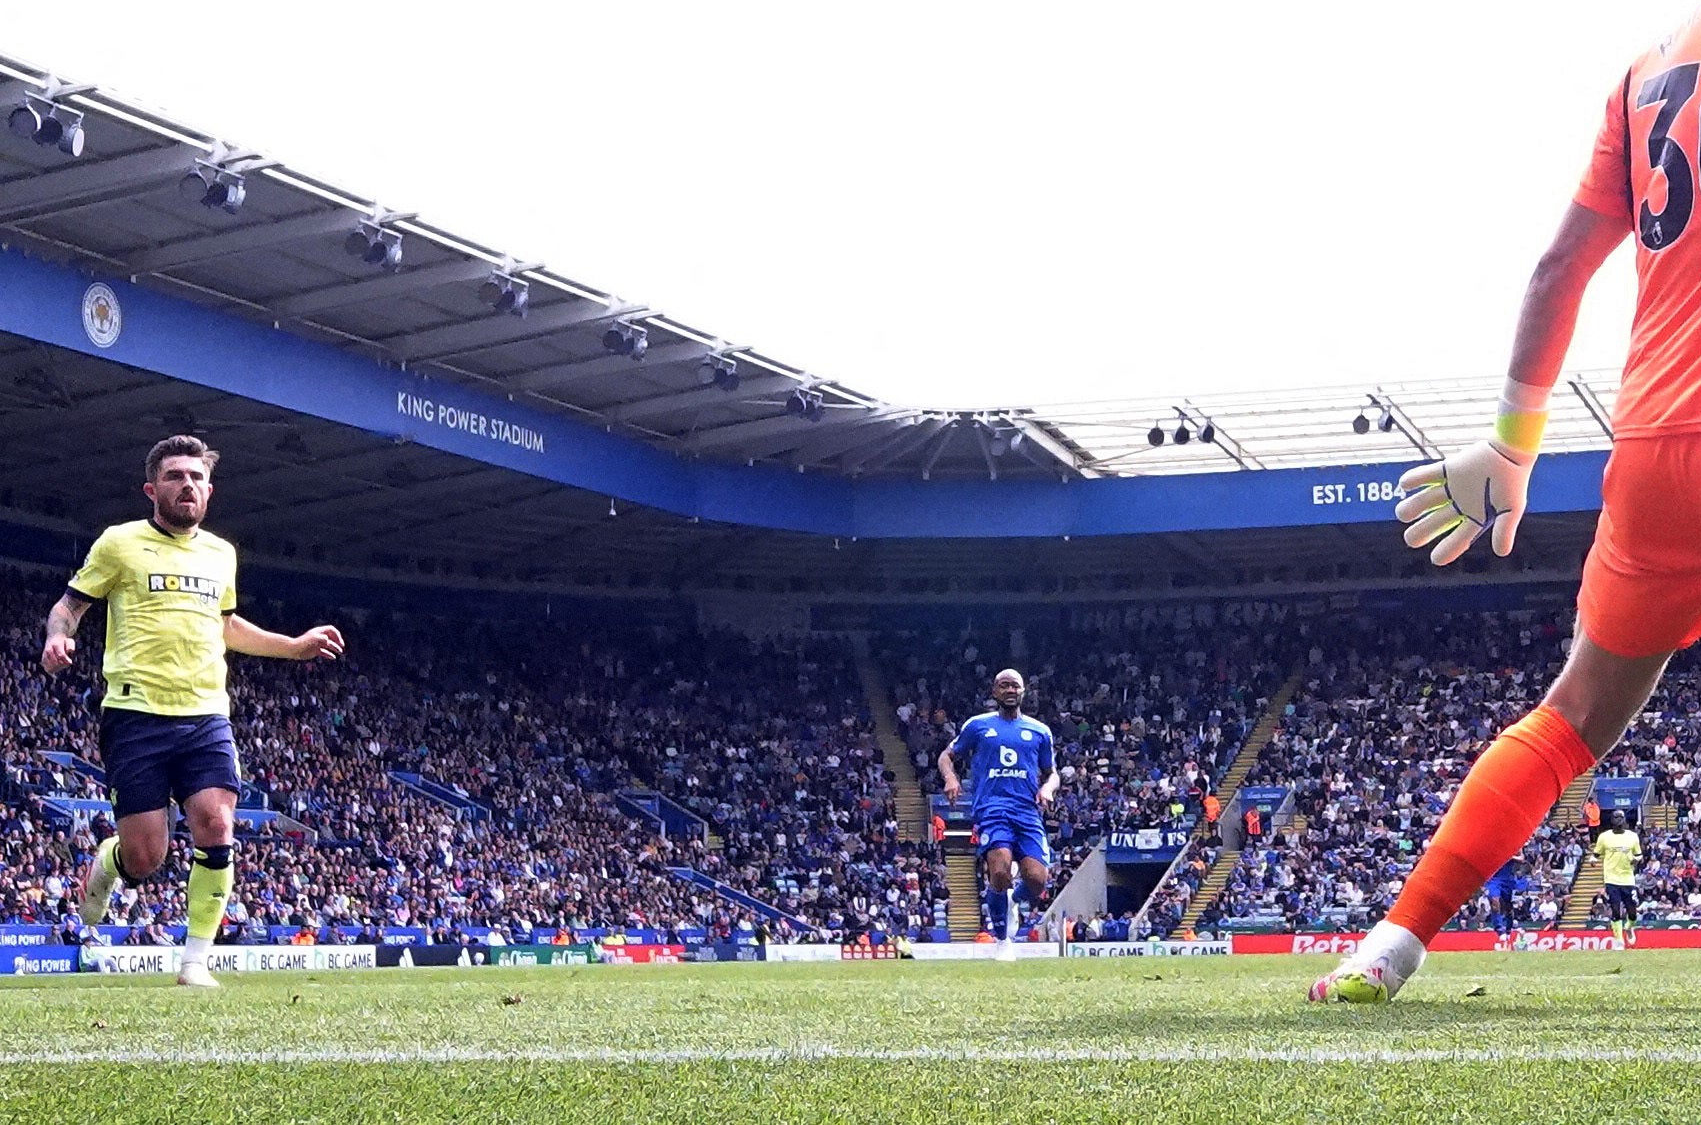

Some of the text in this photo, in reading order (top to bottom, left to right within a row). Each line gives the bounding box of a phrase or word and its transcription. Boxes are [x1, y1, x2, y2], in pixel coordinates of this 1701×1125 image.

[397, 392, 544, 453] KING POWER STADIUM
[1312, 481, 1407, 505] EST. 1884
[1089, 947, 1145, 957] BCGAME
[1292, 935, 1358, 953] Beta
[41, 958, 71, 972] POWER
[207, 954, 238, 971] GAME
[260, 954, 307, 970] BC.GAME
[328, 953, 372, 969] BC.GAME
